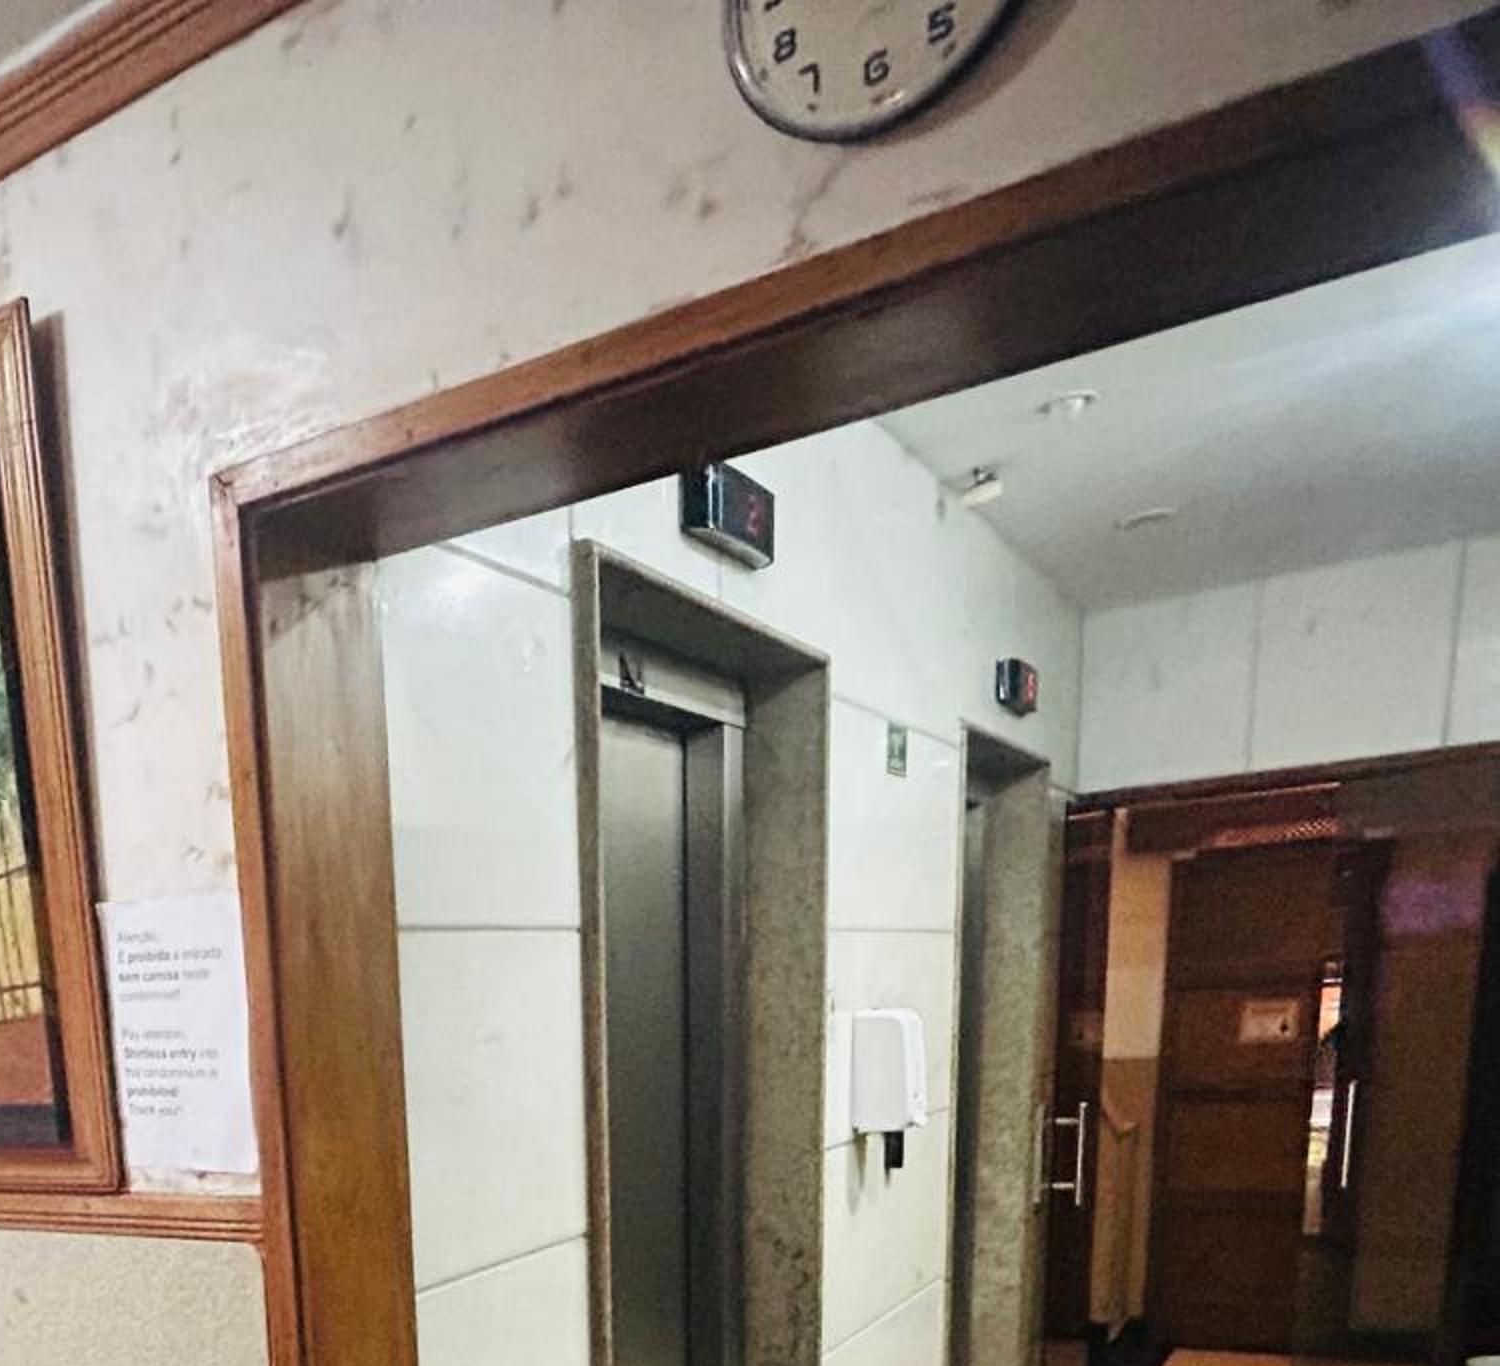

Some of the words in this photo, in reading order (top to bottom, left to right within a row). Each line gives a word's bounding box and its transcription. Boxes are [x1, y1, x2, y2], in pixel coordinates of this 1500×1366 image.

[927, 2, 958, 45] 5
[772, 26, 797, 64] 8
[799, 62, 821, 95] 7
[863, 48, 891, 87] 6
